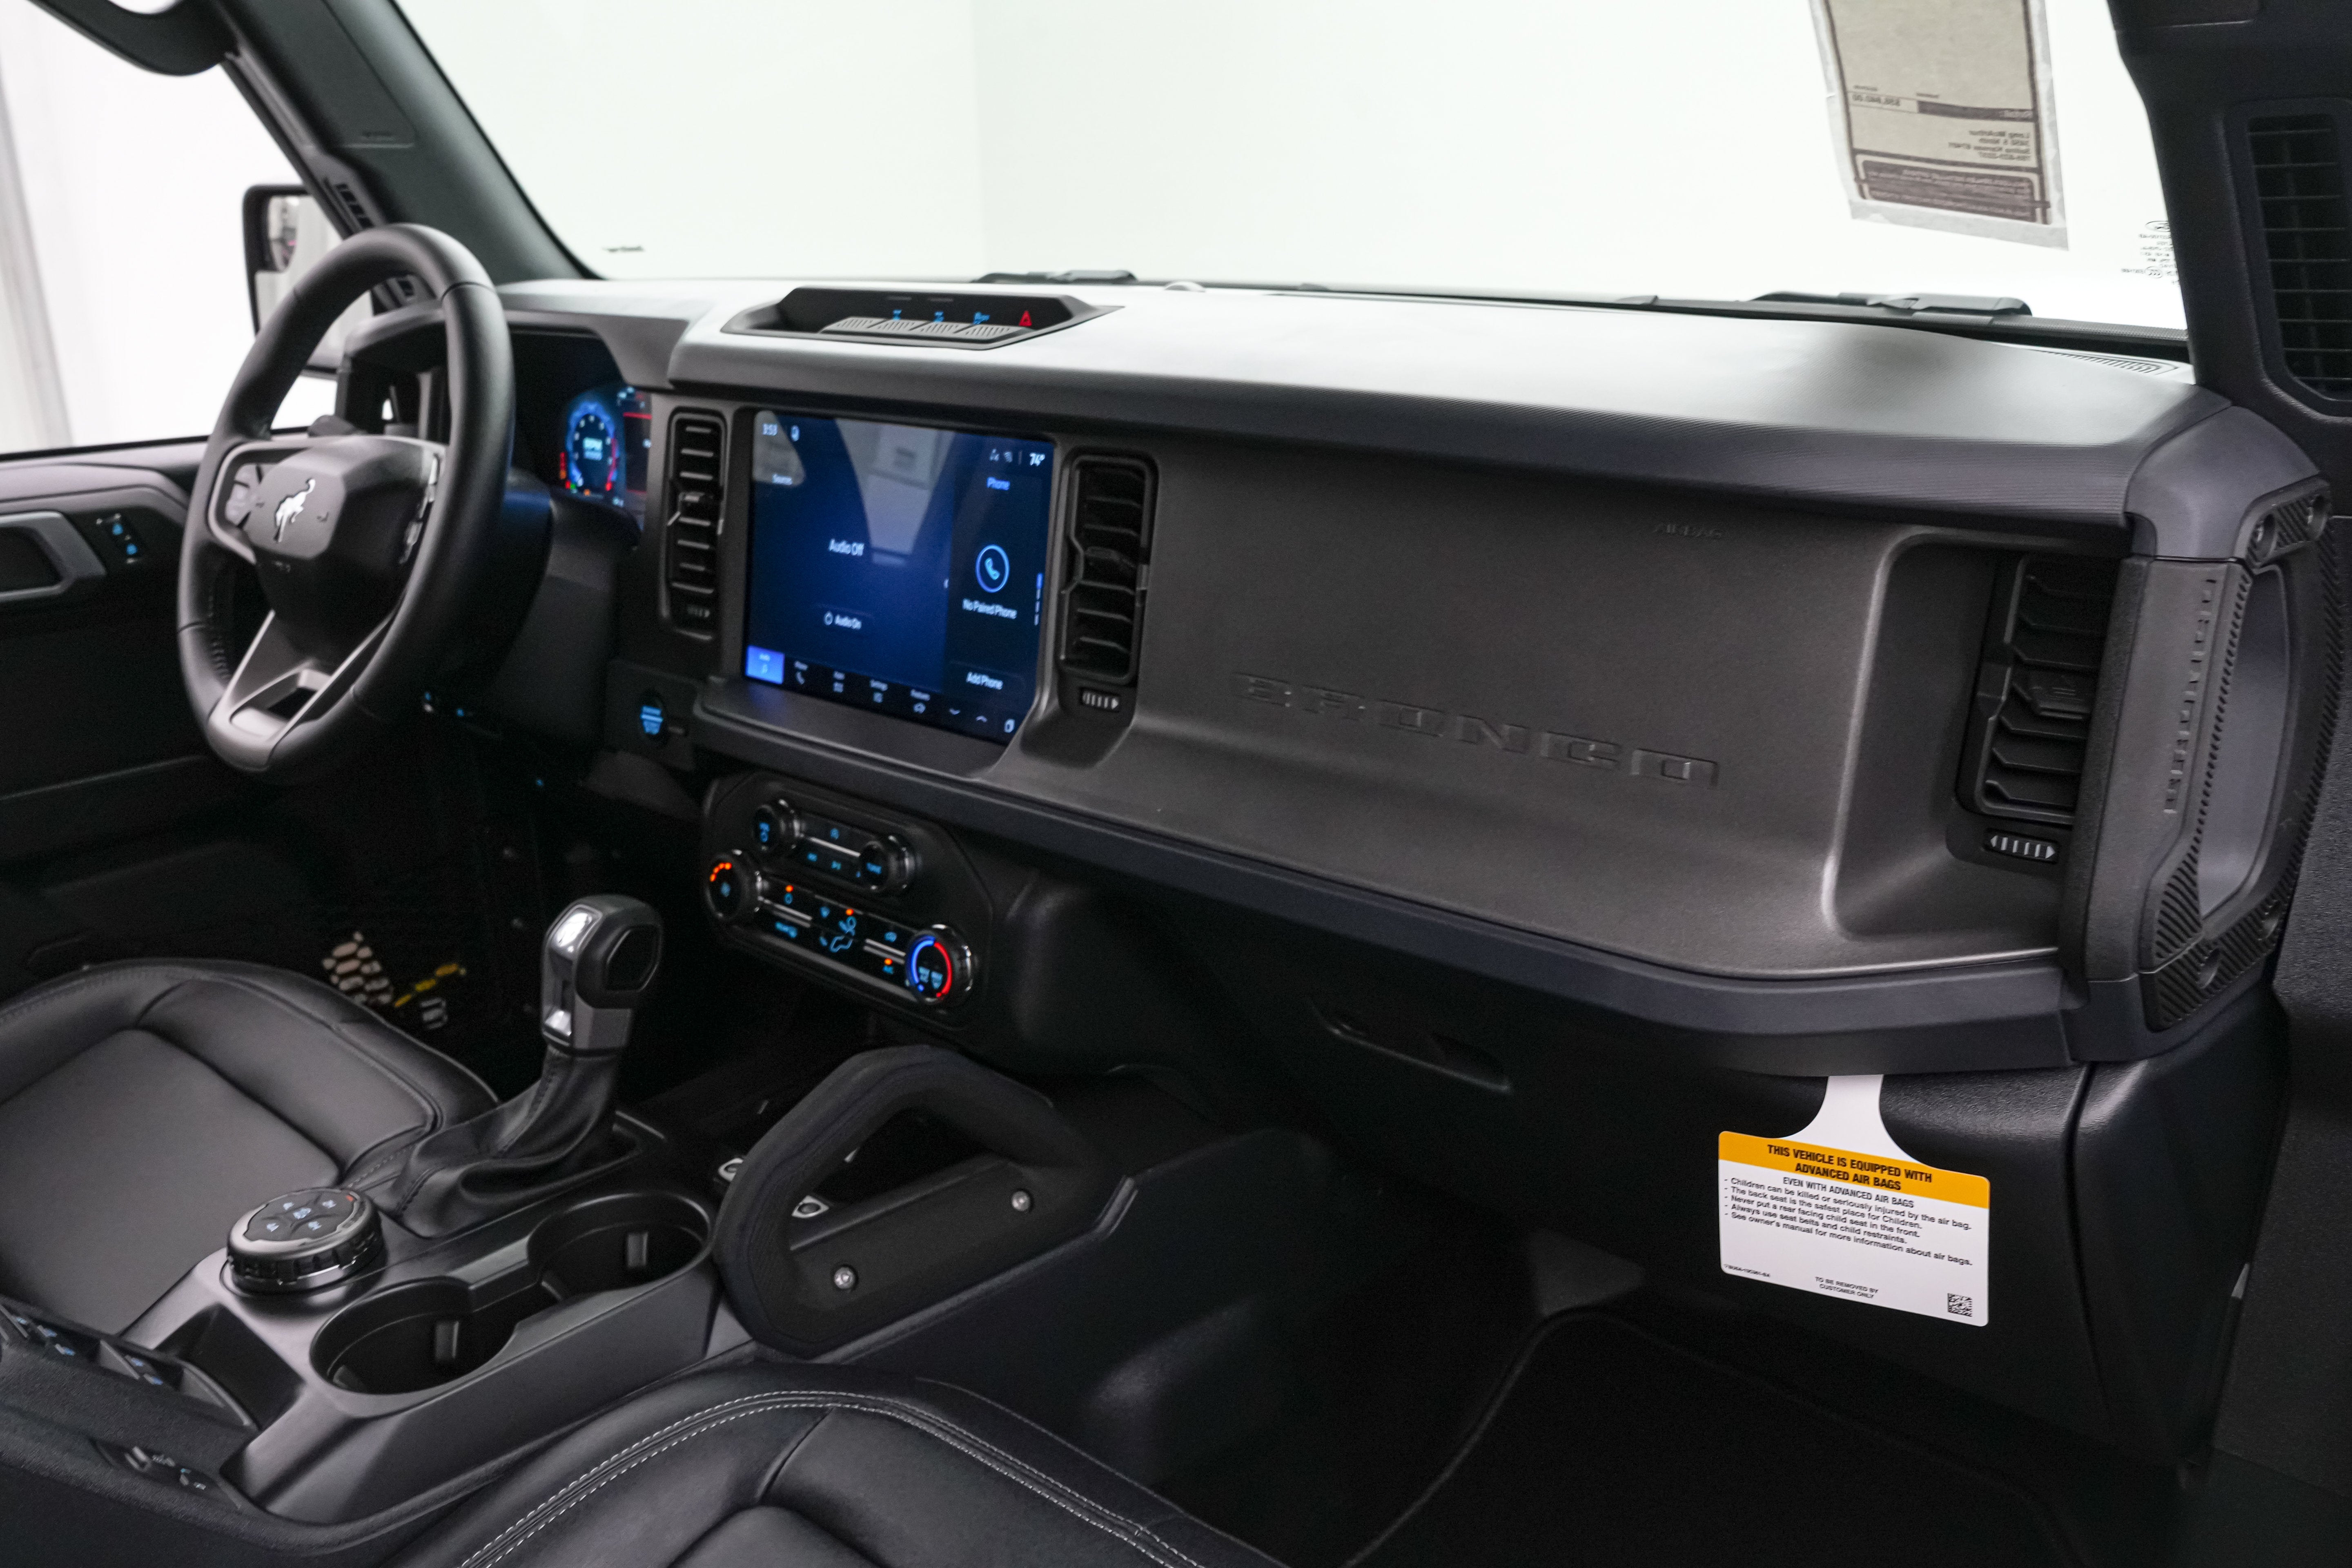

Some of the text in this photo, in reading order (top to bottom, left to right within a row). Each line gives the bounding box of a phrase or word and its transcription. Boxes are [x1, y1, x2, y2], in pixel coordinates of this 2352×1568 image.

[987, 477, 1010, 490] Phone
[829, 539, 865, 556] Audio Off
[835, 614, 852, 628] Audio
[962, 598, 1017, 619] No Paired Phone
[966, 672, 1003, 690] Add Phone
[1768, 1145, 1932, 1183] THIS VEHICLE IS EQUIPPED WITH
[1795, 1163, 1901, 1190] ADVANCED AIR BAGS
[1731, 1178, 1765, 1190] Children
[1785, 1187, 1794, 1196] be
[1797, 1190, 1819, 1200] killed
[1833, 1198, 1873, 1212] seriously
[1875, 1205, 1904, 1217] injured
[1908, 1211, 1919, 1221] by
[1921, 1214, 1935, 1223] the
[1952, 1220, 1972, 1230] bag.
[1783, 1177, 1914, 1208] EVEN WITH ADVANCED AIR BAGS
[1731, 1195, 1754, 1205] Never
[1757, 1201, 1770, 1209] put
[1798, 1207, 1823, 1220] facing
[1826, 1214, 1846, 1223] child
[1849, 1218, 1867, 1227] seat
[1880, 1223, 1894, 1232] the
[1896, 1227, 1920, 1238] front.
[1732, 1186, 1746, 1195] The
[1748, 1189, 1768, 1199] back
[1770, 1194, 1787, 1203] seat
[1799, 1200, 1812, 1209] the
[1814, 1204, 1840, 1213] safest
[1842, 1209, 1865, 1219] place
[1868, 1213, 1880, 1221] for
[1882, 1216, 1922, 1229] Children.
[1731, 1203, 1760, 1215] Always
[1780, 1213, 1797, 1222] seat
[1799, 1216, 1819, 1227] belts
[1822, 1222, 1837, 1230] and
[1840, 1225, 1861, 1234] child
[1863, 1230, 1907, 1244] restraints.
[1731, 1212, 1746, 1221] See
[1782, 1222, 1813, 1234] manual
[1815, 1228, 1827, 1237] for
[1829, 1232, 1851, 1241] more
[1854, 1236, 1904, 1252] information
[1906, 1247, 1931, 1258] about
[1947, 1254, 1973, 1266] bags.
[1819, 1283, 1875, 1299] CUSTOMER ONLY
[1836, 1281, 1868, 1292] REMOVED
